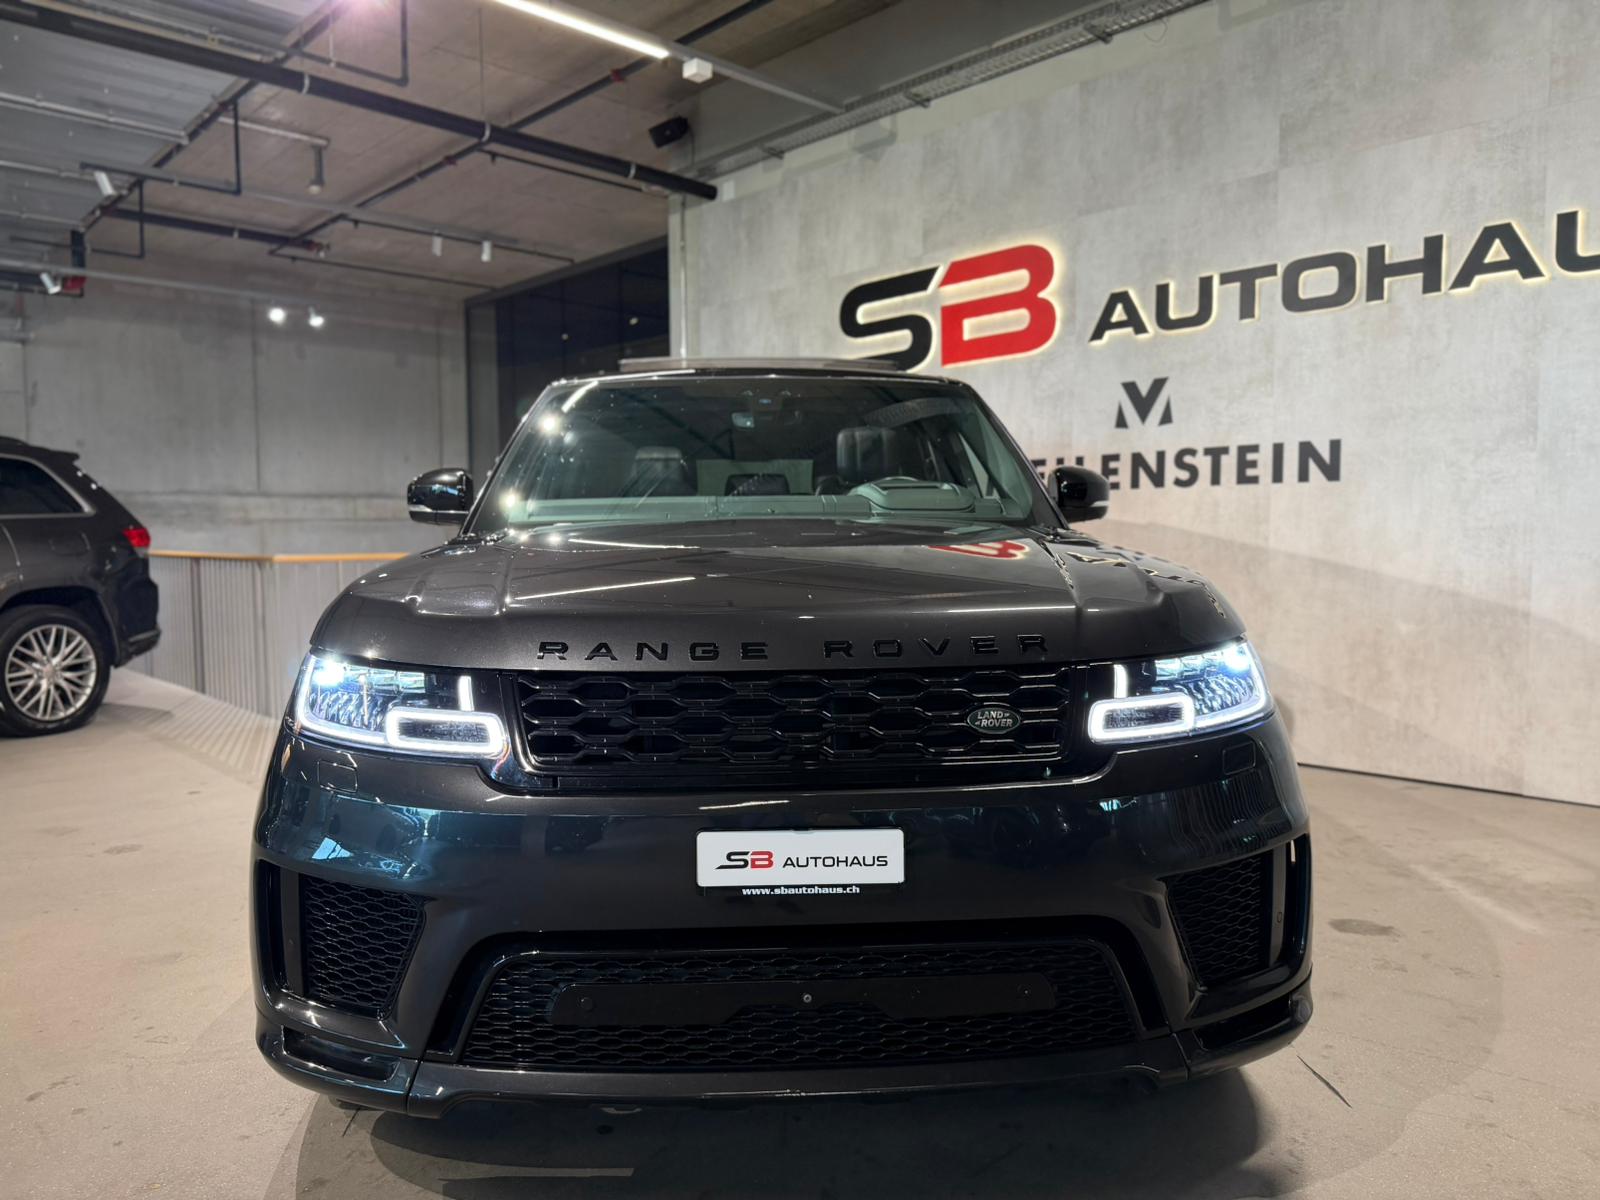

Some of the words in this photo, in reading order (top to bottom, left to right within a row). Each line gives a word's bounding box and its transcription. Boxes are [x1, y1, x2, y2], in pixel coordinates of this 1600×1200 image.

[840, 244, 1056, 372] SB
[1031, 439, 1342, 491] ENSTEIN
[537, 641, 769, 661] RANGE
[823, 634, 1049, 659] ROVER
[977, 710, 1004, 720] LAND
[980, 718, 1013, 728] ROVER
[715, 850, 774, 870] SB
[782, 855, 888, 868] AUTOHAUS
[741, 885, 861, 896] www.sbautohaus.ch
